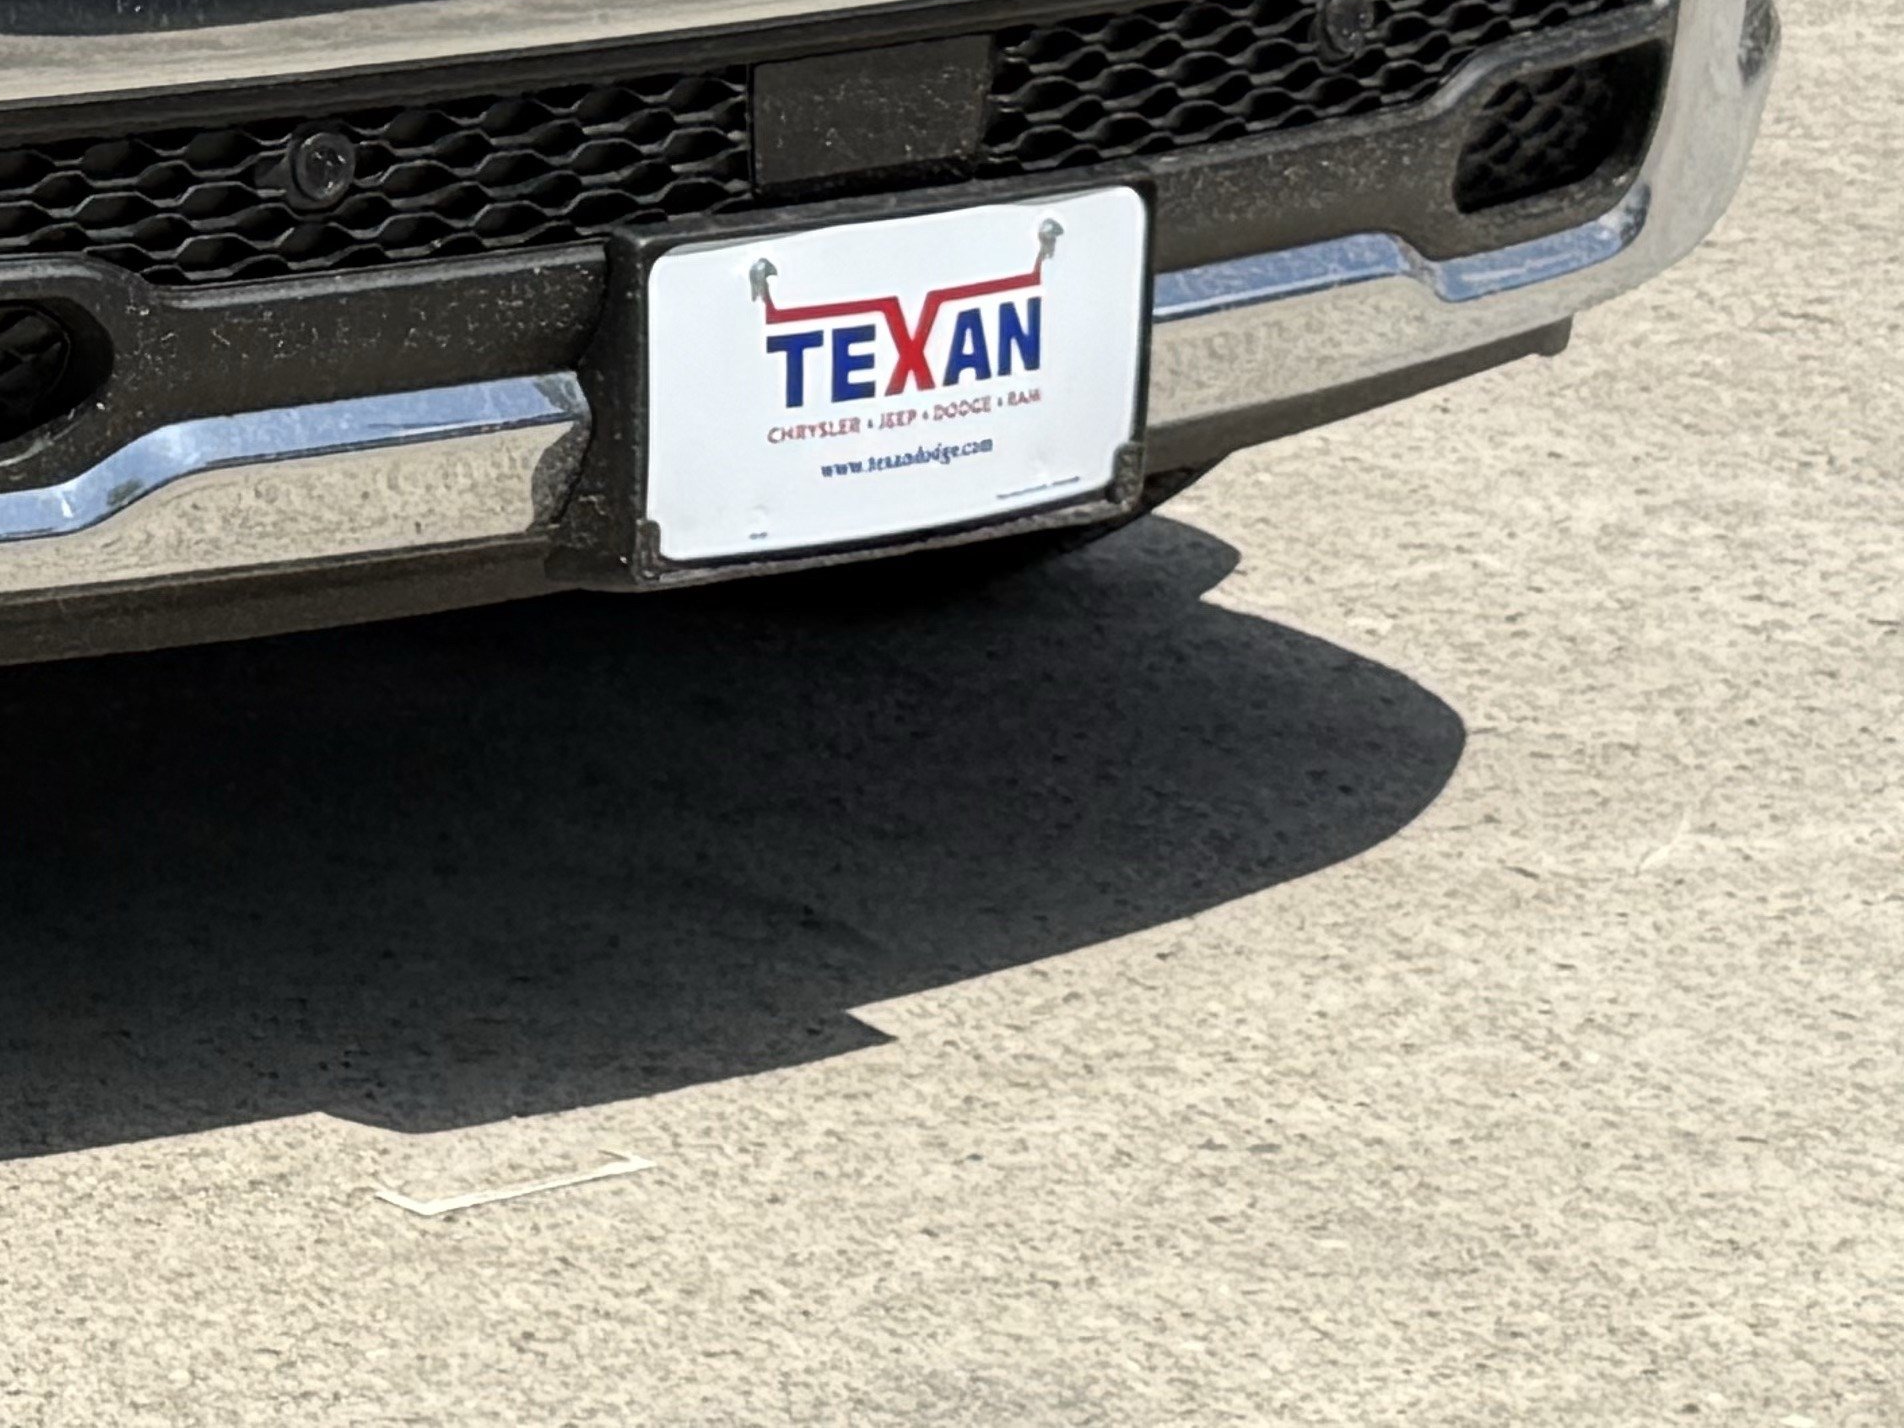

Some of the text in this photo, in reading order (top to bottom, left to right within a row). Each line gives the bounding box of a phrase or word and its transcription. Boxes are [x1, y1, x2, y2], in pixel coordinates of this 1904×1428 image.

[764, 286, 1043, 409] TEXAN
[766, 388, 1042, 445] CHRYSLER JEEP DODGE RAM
